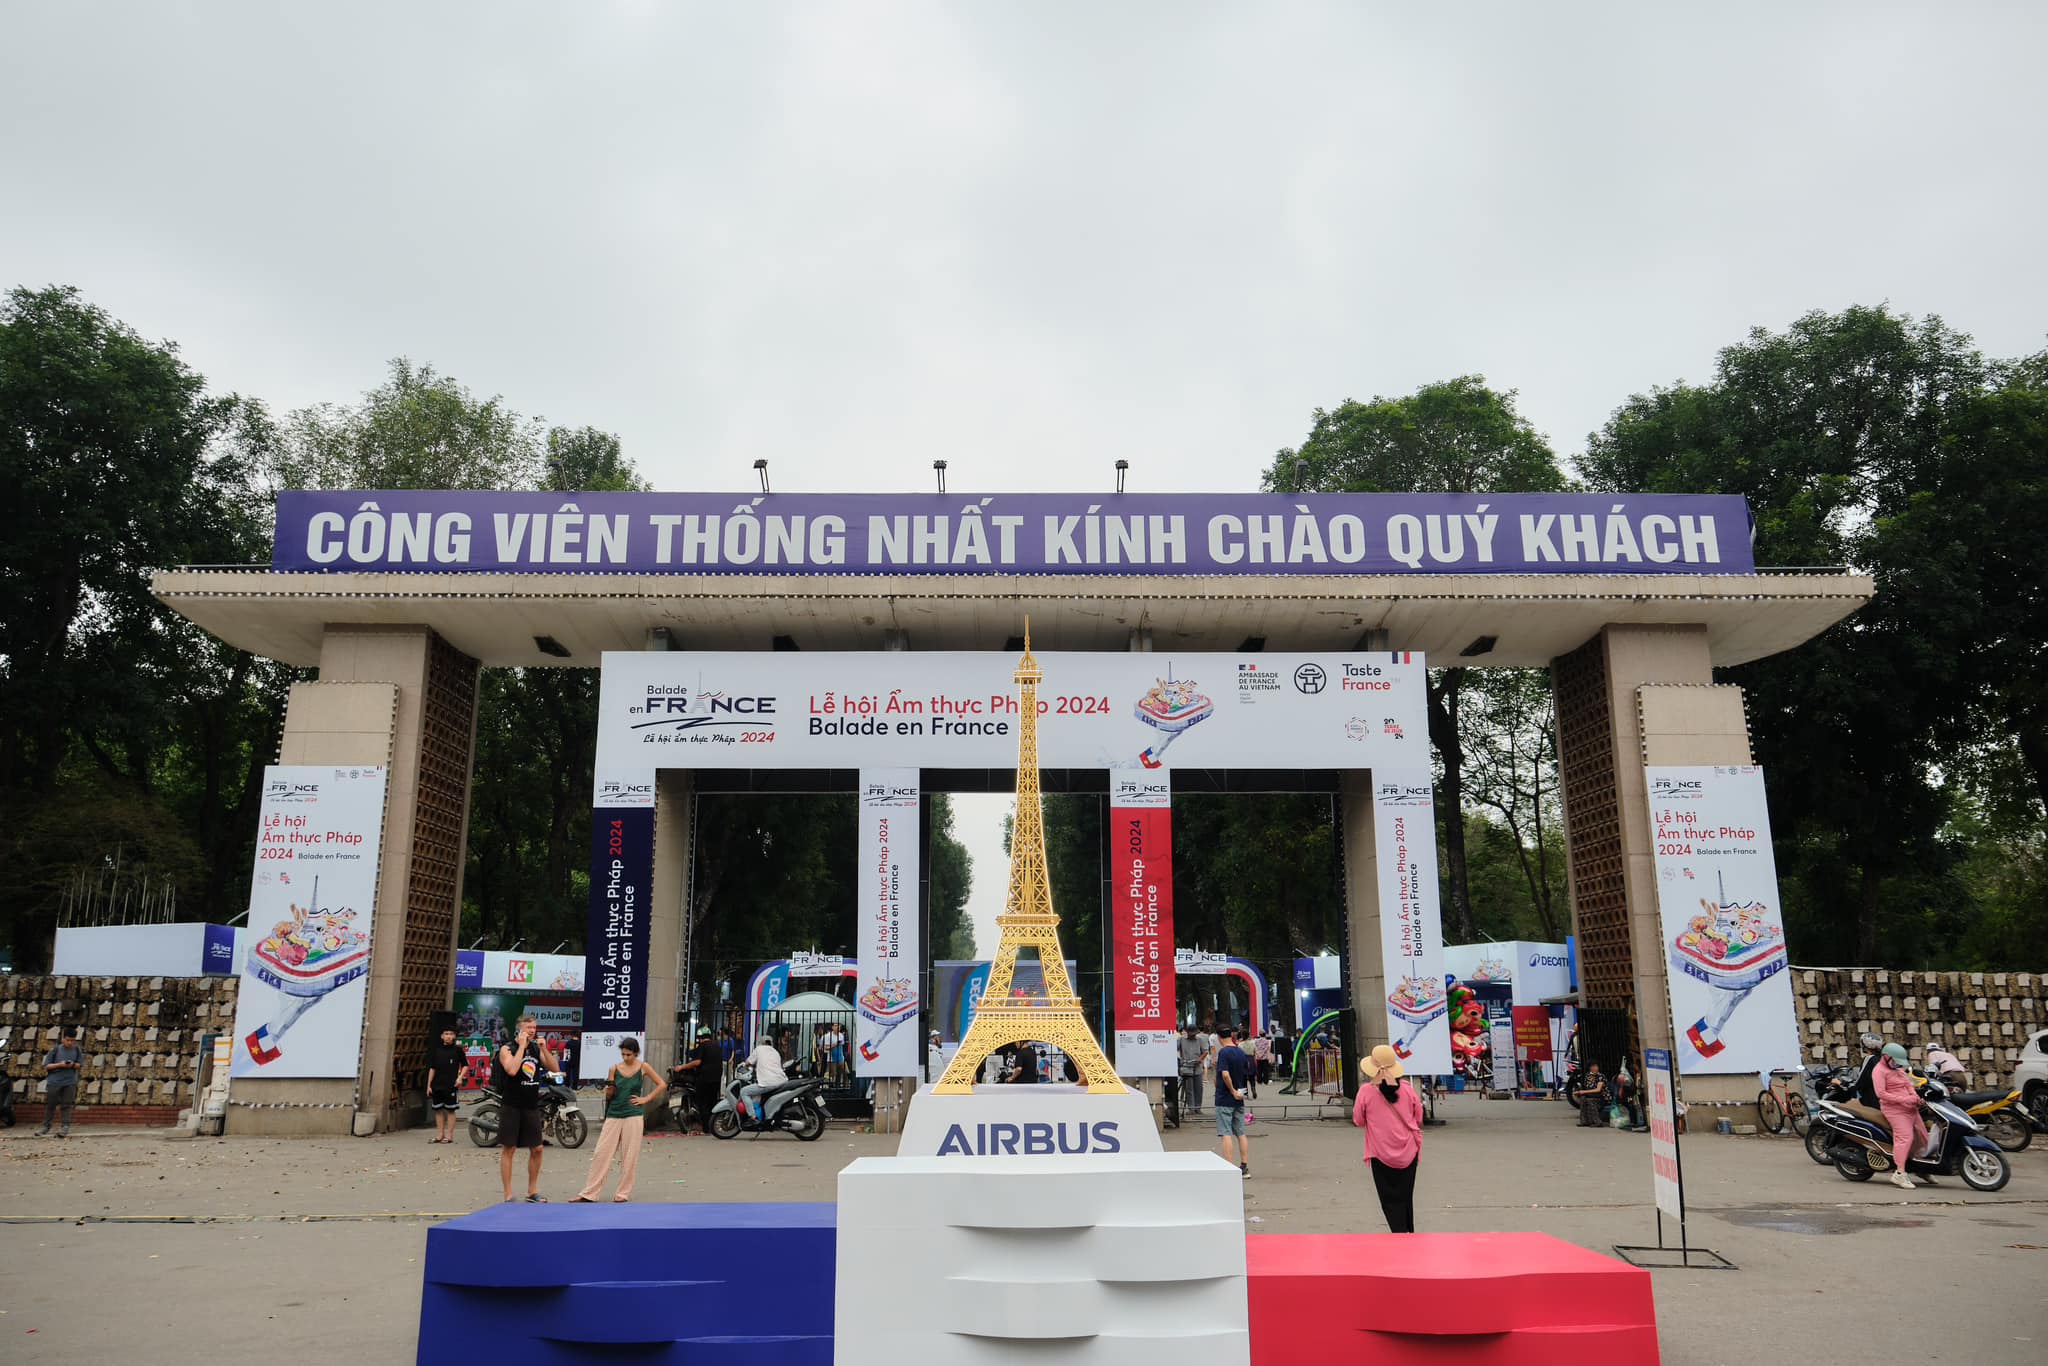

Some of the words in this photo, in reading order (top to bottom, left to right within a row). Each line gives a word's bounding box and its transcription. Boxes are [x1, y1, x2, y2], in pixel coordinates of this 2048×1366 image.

[306, 501, 472, 563] CÔNG
[493, 503, 630, 563] VIÊN
[649, 497, 846, 565] THỐNG
[867, 497, 1024, 564] NHẤT
[1044, 504, 1187, 564] KÍNH
[1207, 504, 1366, 564] CHÀO
[1386, 504, 1499, 569] QUÝ
[1519, 504, 1721, 563] KHÁCH
[1342, 663, 1382, 676] Taste
[647, 685, 687, 695] Balade
[1342, 678, 1391, 690] France
[629, 704, 643, 714] en
[809, 691, 836, 714] Lễ
[844, 695, 878, 719] hội
[885, 689, 923, 714] Ẩm
[931, 695, 982, 719] thực
[991, 695, 1049, 718] Php
[1056, 696, 1111, 714] 2024
[739, 731, 775, 743] 2024
[809, 717, 889, 736] Balade
[896, 722, 923, 736] en
[932, 717, 1009, 736] France
[264, 813, 280, 827] Lễ
[284, 815, 306, 830] hội
[1395, 817, 1405, 842] 2024
[1655, 809, 1672, 823] Lễ
[1675, 811, 1697, 826] hội
[290, 831, 322, 847] thực
[326, 831, 363, 846] Pháp
[609, 820, 623, 856] 2024
[879, 818, 888, 843] 2024
[1130, 819, 1142, 854] 2024
[1684, 827, 1716, 842] thực
[1719, 826, 1756, 841] Pháp
[260, 848, 293, 860] 2024
[878, 846, 890, 873] Pháp
[1396, 845, 1408, 873] Pháp
[1658, 843, 1692, 856] 2024
[607, 859, 624, 898] Pháp
[878, 876, 890, 901] thực
[889, 864, 899, 901] France
[1130, 859, 1146, 898] Pháp
[1399, 875, 1410, 900] thực
[1410, 863, 1420, 900] France
[605, 903, 623, 938] thực
[619, 885, 635, 937] France
[891, 904, 899, 917] en
[1131, 902, 1147, 937] thực
[1146, 885, 1158, 936] France
[1412, 902, 1421, 916] en
[889, 920, 899, 958] Balade
[1150, 941, 1159, 960] en
[1412, 919, 1423, 957] Balade
[622, 942, 633, 960] en
[510, 962, 531, 981] K+
[1132, 972, 1149, 995] hội
[602, 973, 620, 997] hội
[616, 964, 631, 1020] Balade
[1147, 964, 1161, 1018] Balade
[599, 1001, 615, 1020] Lễ
[1130, 1000, 1146, 1018] Lễ
[936, 1121, 1121, 1156] AIRBUS
